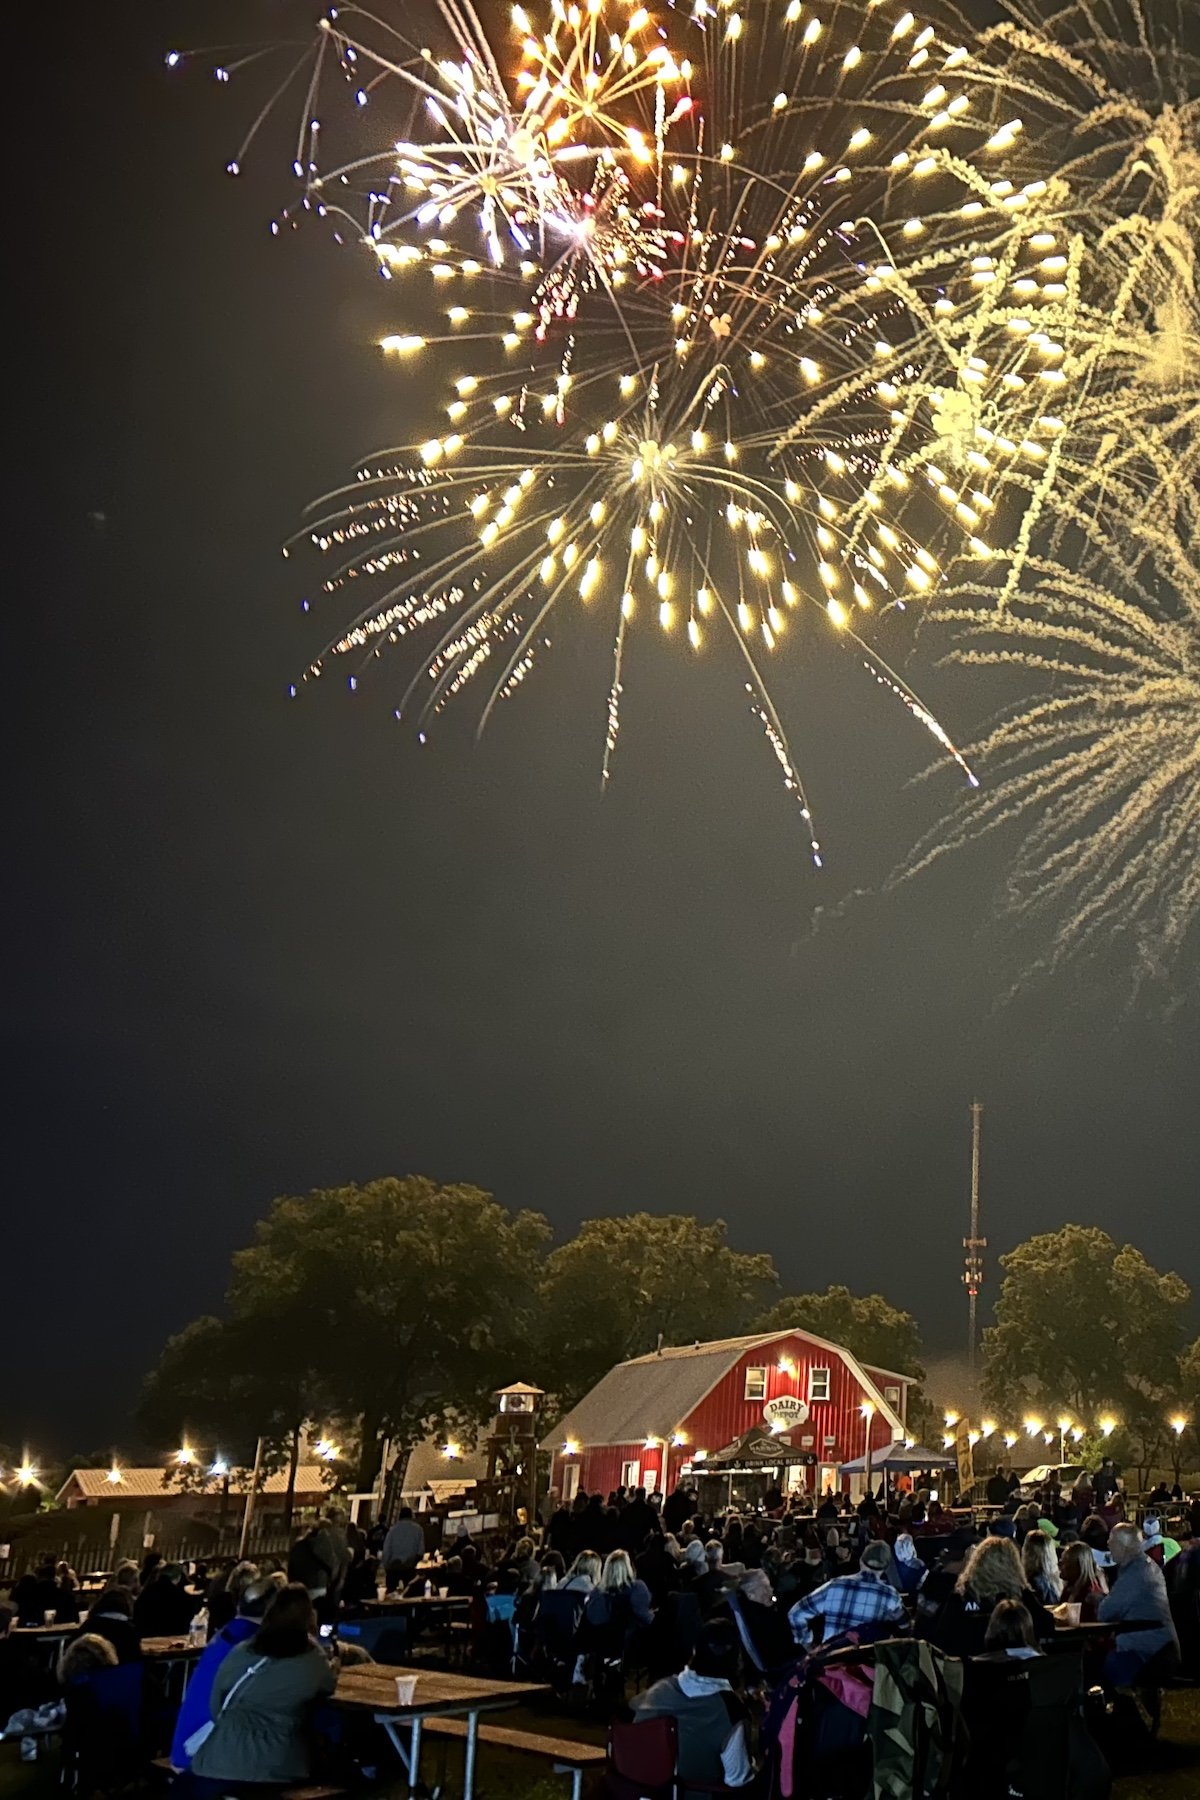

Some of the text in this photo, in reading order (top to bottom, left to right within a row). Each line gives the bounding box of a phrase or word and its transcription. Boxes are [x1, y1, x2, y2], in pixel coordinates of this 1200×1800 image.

[770, 1400, 804, 1412] DAIRY
[745, 1460, 765, 1468] DRINK
[765, 1458, 785, 1467] LOCAL
